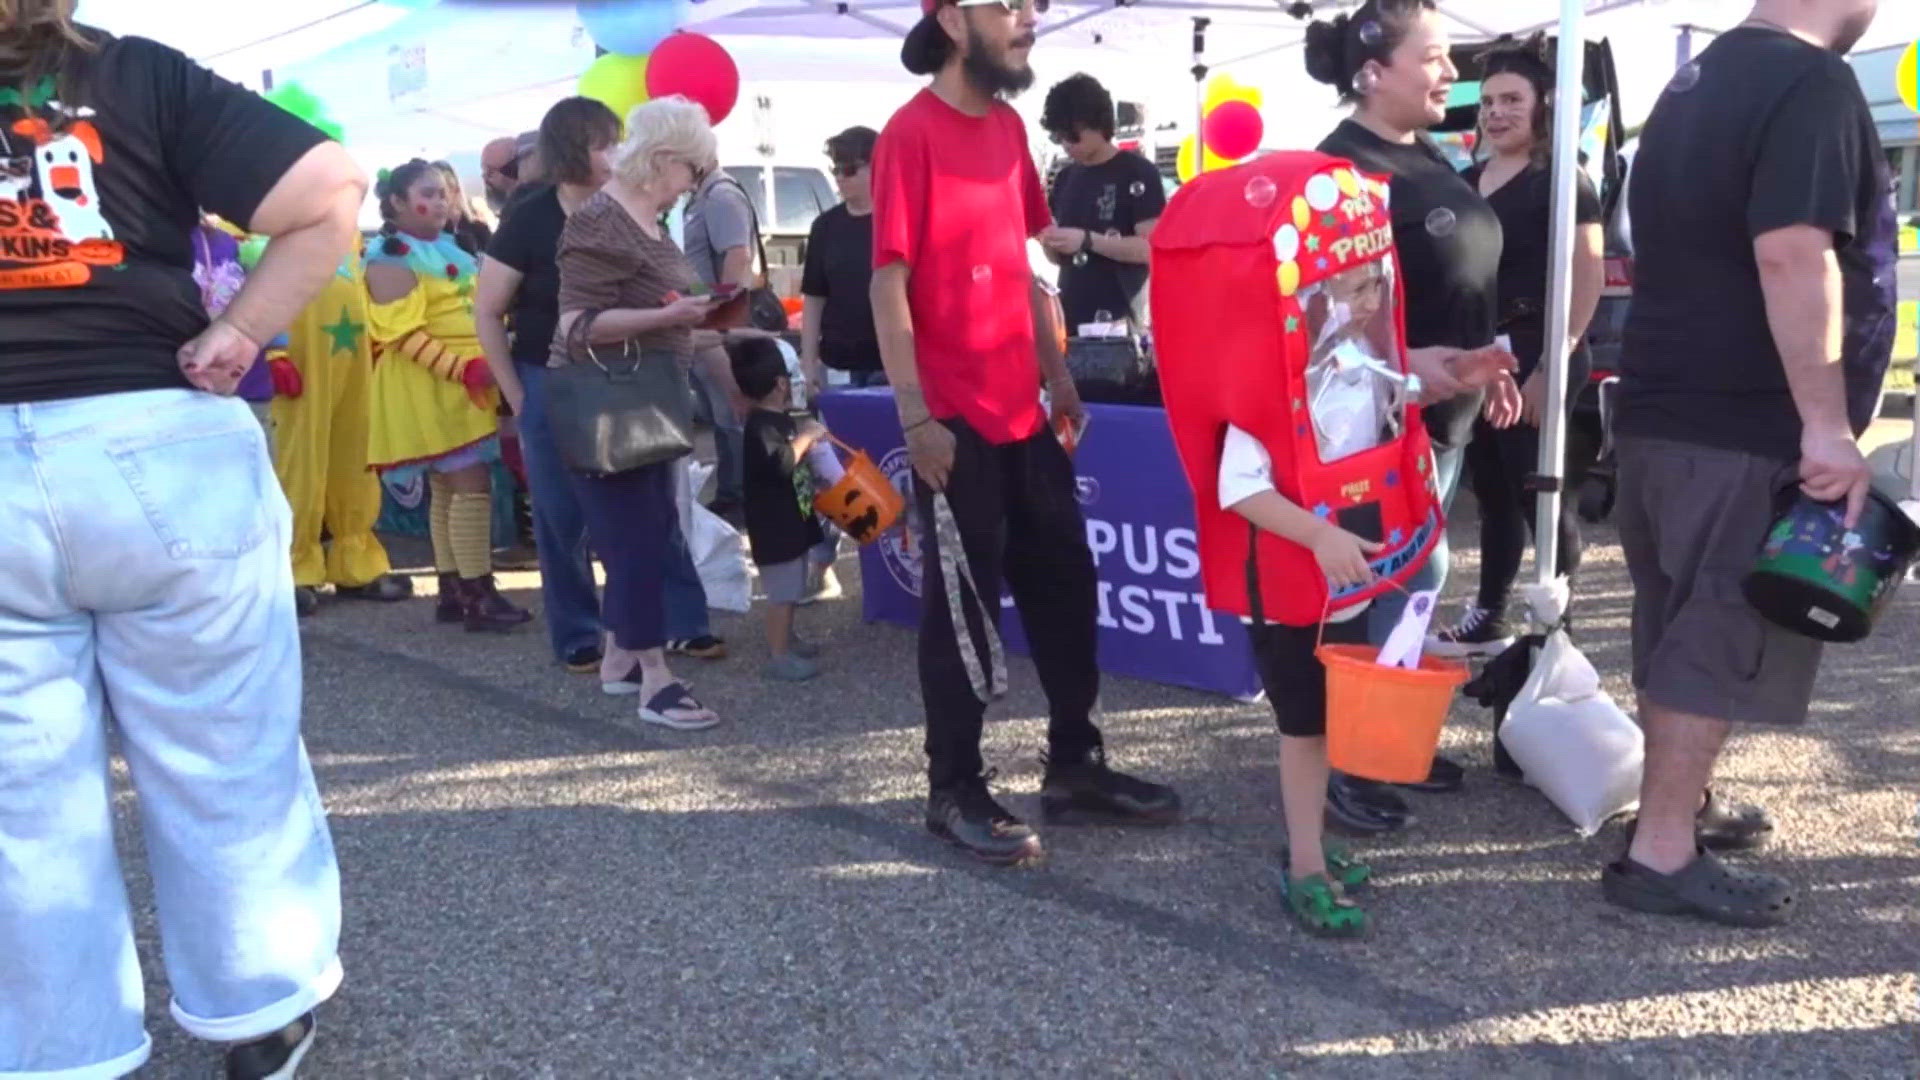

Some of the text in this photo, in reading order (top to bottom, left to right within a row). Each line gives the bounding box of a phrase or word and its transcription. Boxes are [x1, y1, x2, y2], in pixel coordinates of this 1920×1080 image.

[27, 203, 56, 230] &
[3, 236, 70, 257] KINS
[1086, 518, 1200, 579] PUS
[1096, 581, 1224, 645] ISTI
